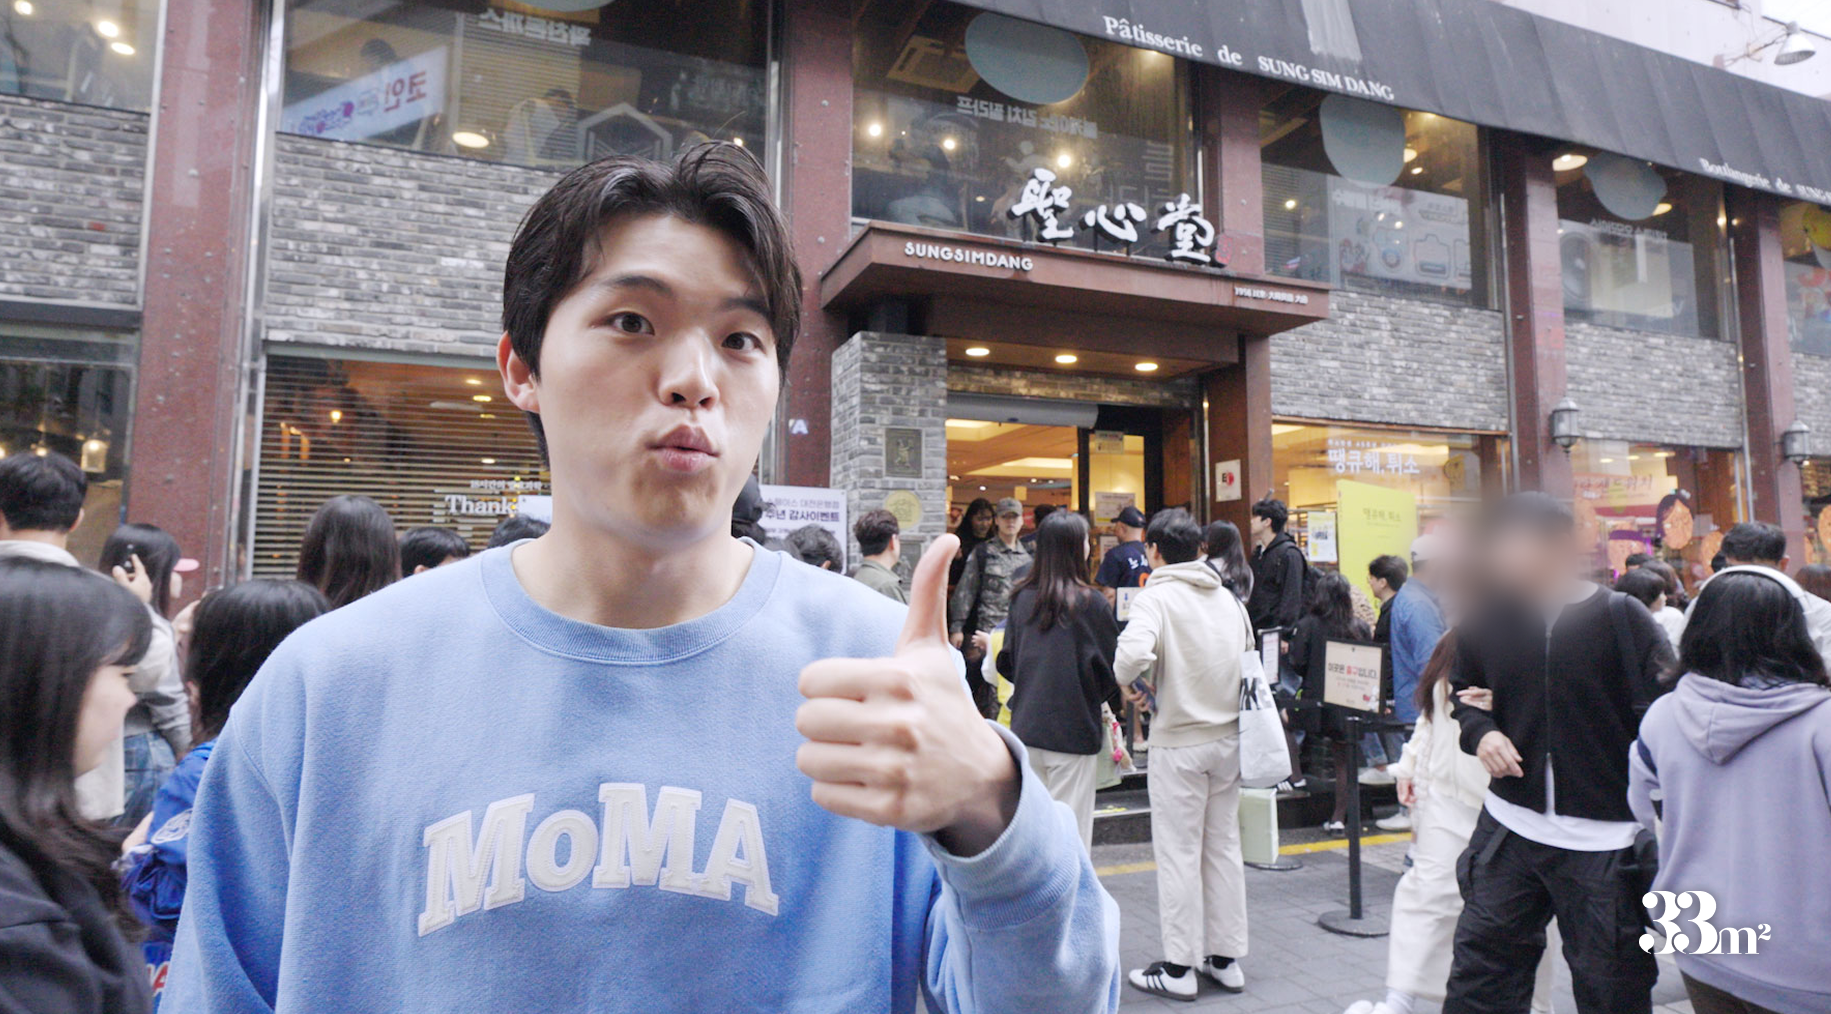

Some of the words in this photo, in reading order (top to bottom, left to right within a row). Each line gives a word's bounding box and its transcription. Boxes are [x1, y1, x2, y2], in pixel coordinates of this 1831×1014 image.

[1103, 16, 1203, 57] Pâtisserie
[1217, 46, 1243, 65] de
[1258, 56, 1310, 82] SUNG
[1311, 68, 1343, 89] SIM
[1345, 77, 1395, 100] DANG
[1776, 177, 1792, 193] de
[1009, 168, 1215, 264] 聖心堂
[904, 241, 1034, 272] SUNGSIMDANG
[789, 509, 840, 523] 감사이벤트
[418, 782, 779, 937] MoMA
